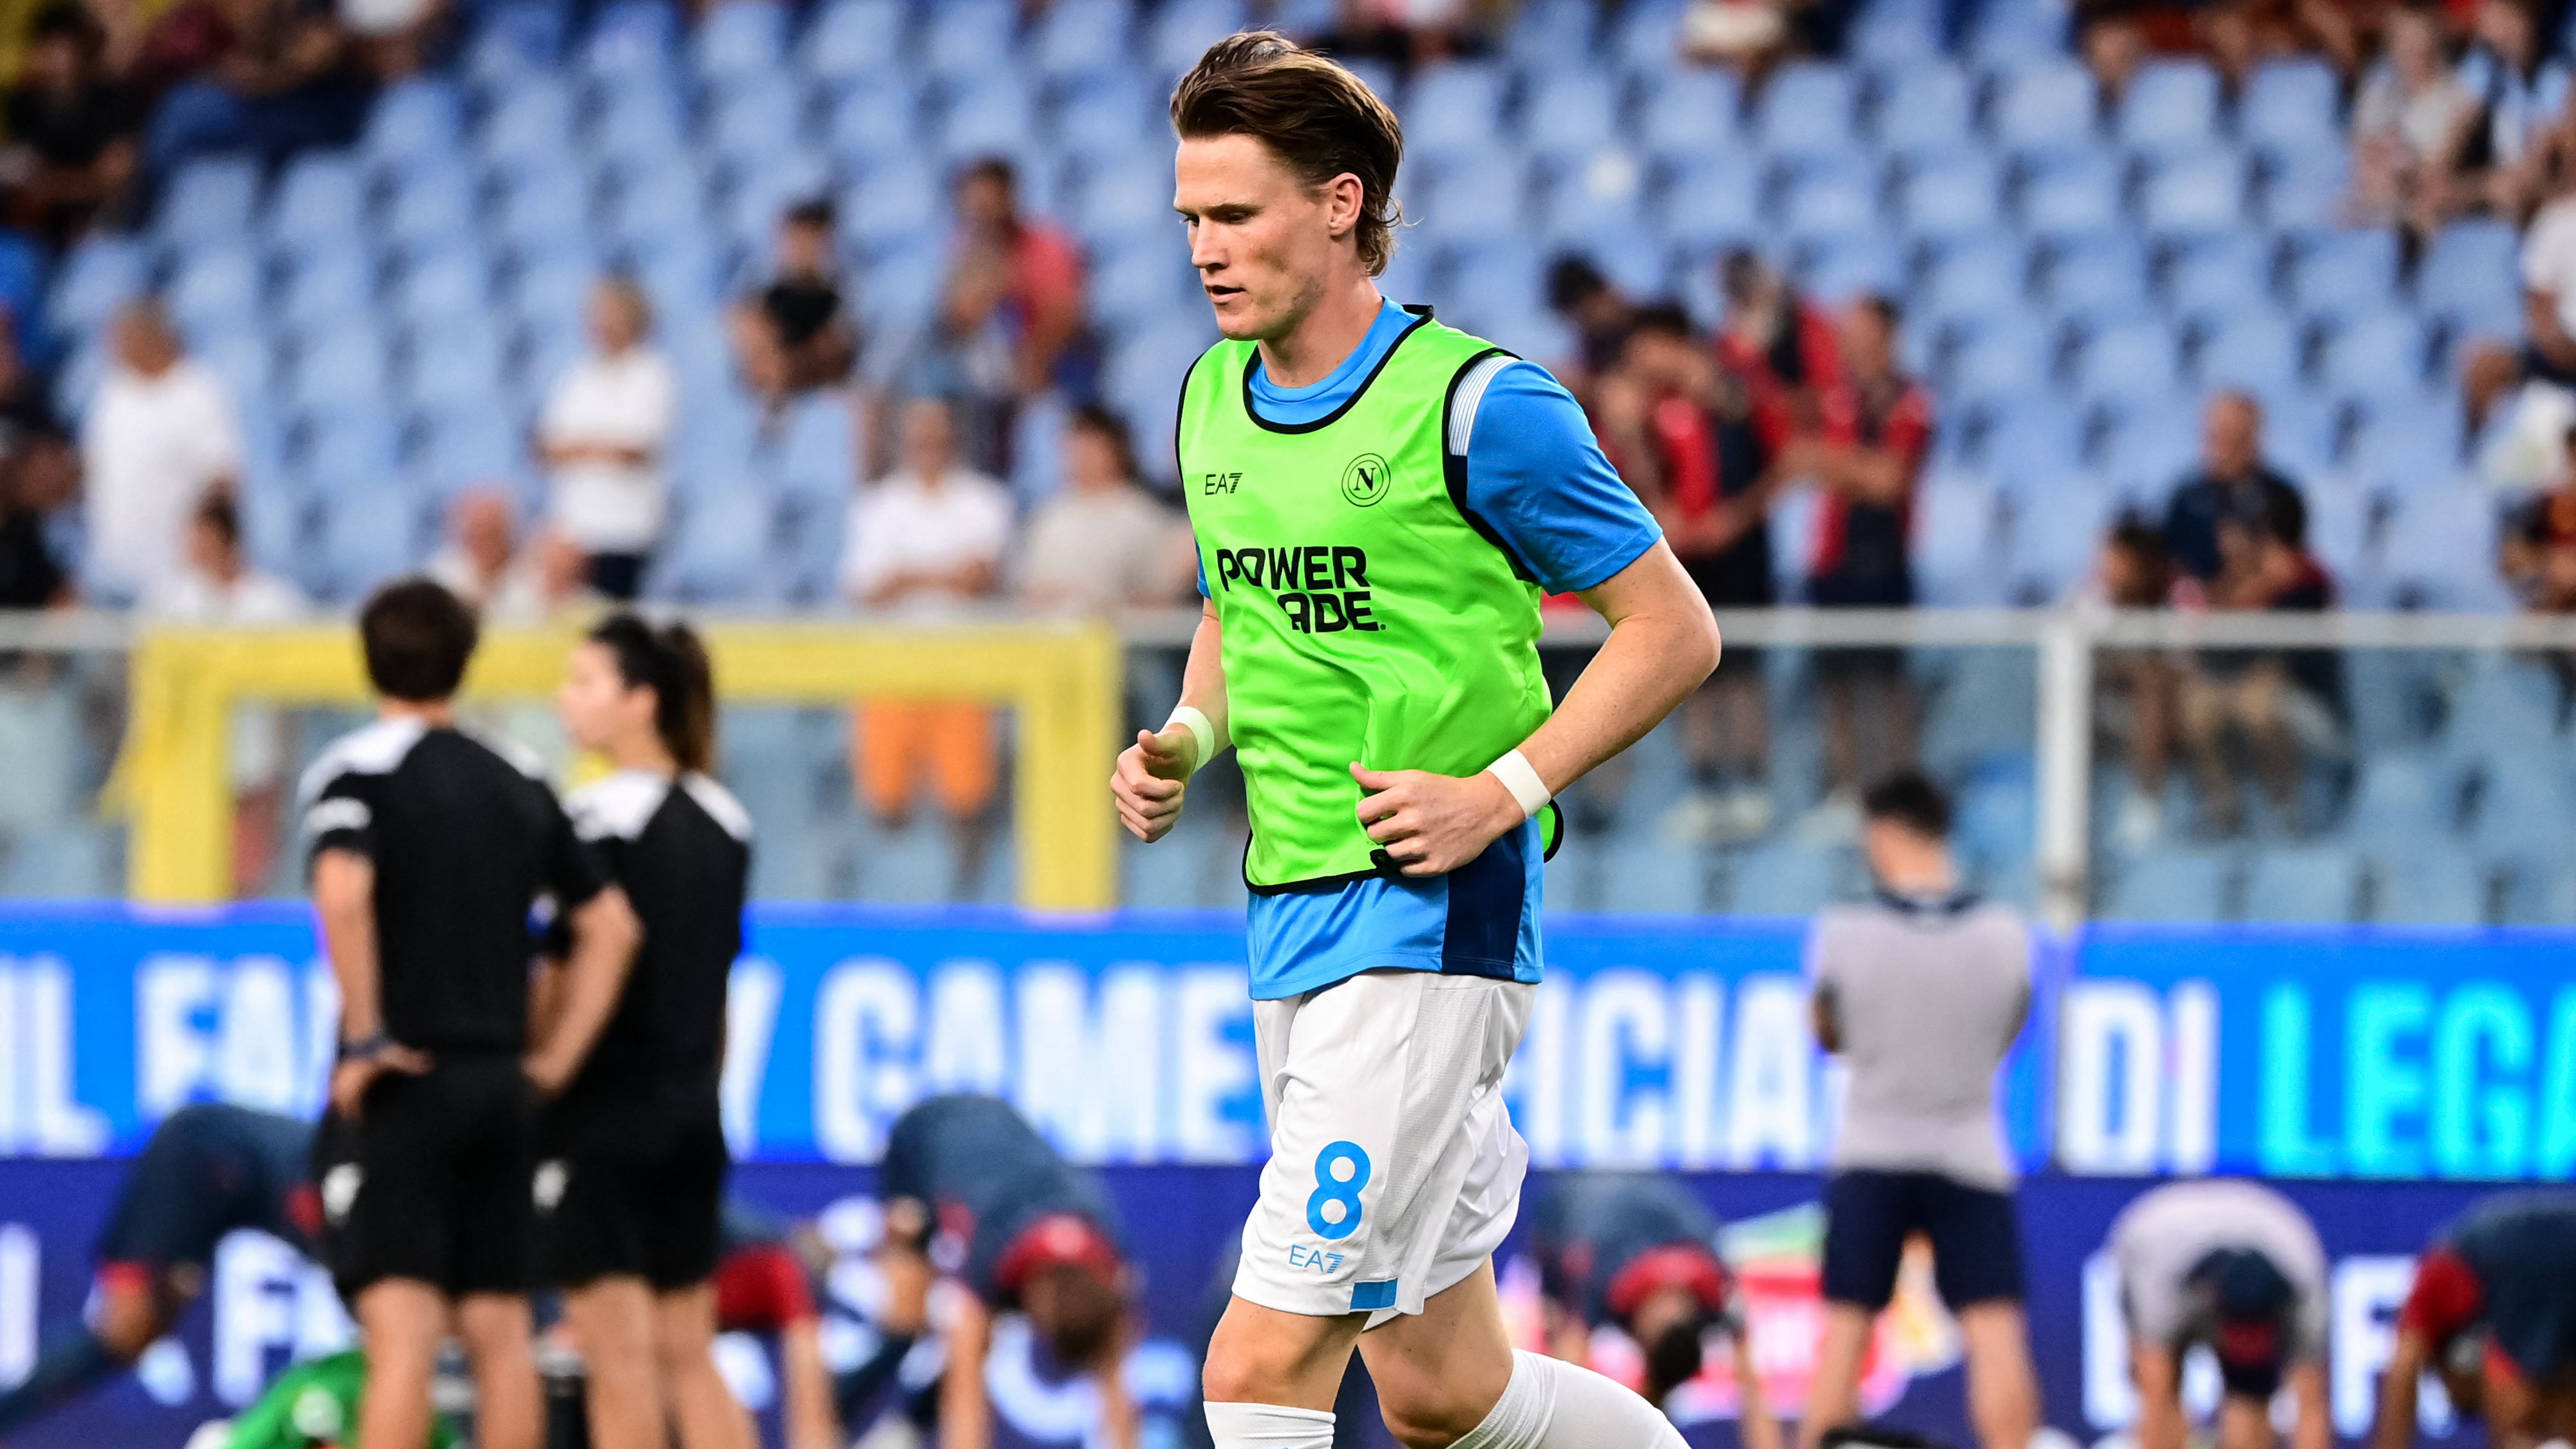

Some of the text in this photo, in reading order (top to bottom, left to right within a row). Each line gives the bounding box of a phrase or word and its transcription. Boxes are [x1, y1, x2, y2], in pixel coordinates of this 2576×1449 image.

[1205, 473, 1243, 495] EA7
[1353, 468, 1377, 491] N
[1217, 546, 1370, 592] POWER
[813, 958, 1253, 1164] GAME
[2060, 980, 2220, 1177] DI
[1307, 1141, 1371, 1240] 8
[1289, 1244, 1345, 1273] EA7
